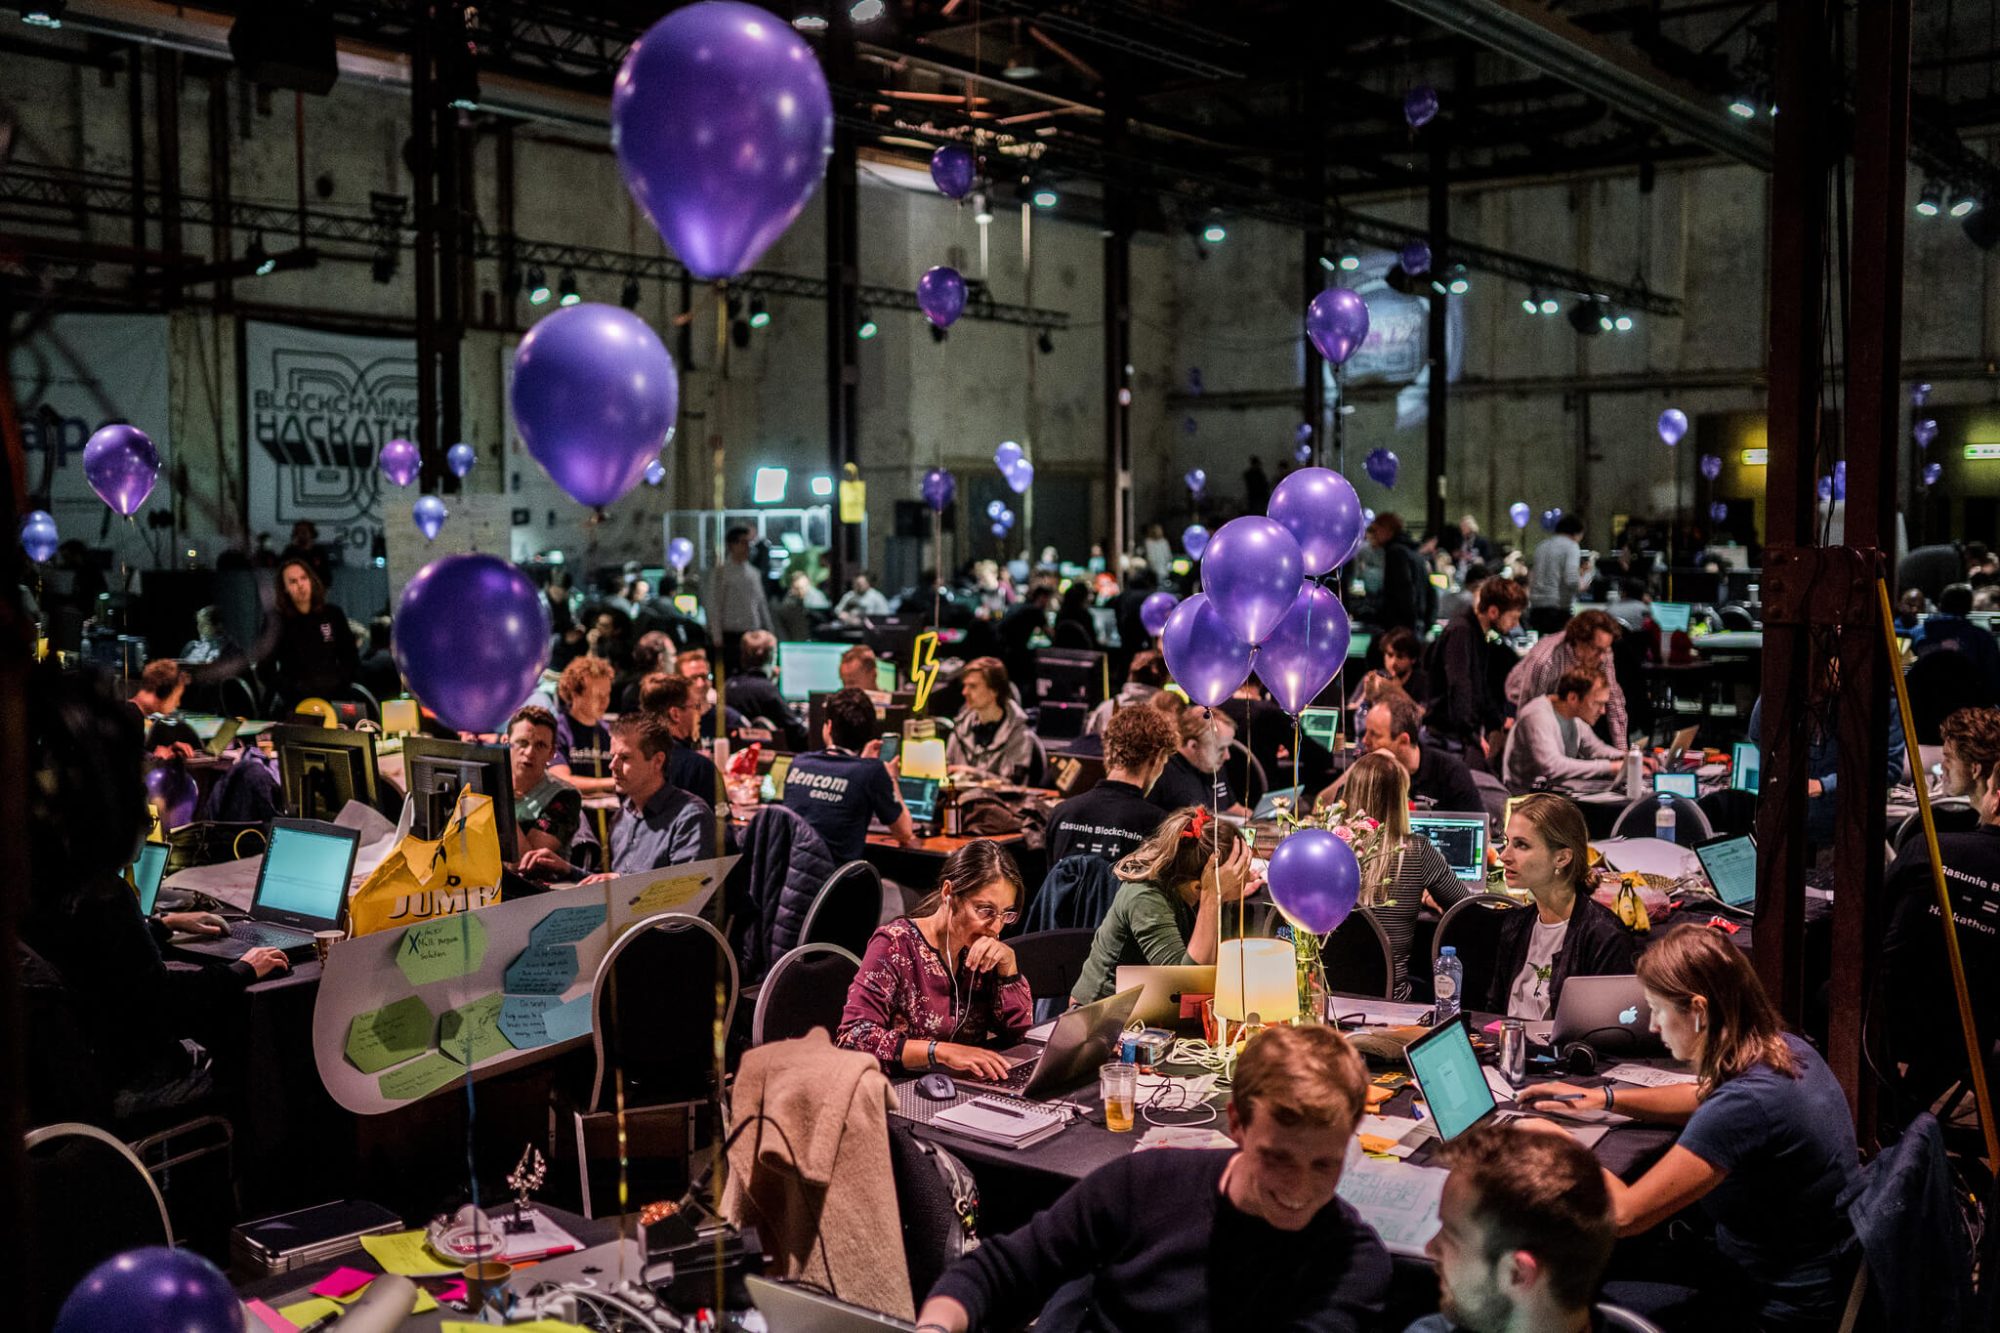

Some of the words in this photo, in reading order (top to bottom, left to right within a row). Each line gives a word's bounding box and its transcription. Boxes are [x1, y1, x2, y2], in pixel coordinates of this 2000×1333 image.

[786, 767, 849, 792] Bencom
[809, 789, 843, 803] GROUP
[1060, 821, 1093, 834] Gasunie
[1094, 825, 1142, 841] Blockchain
[1928, 904, 1996, 935] Hkathon
